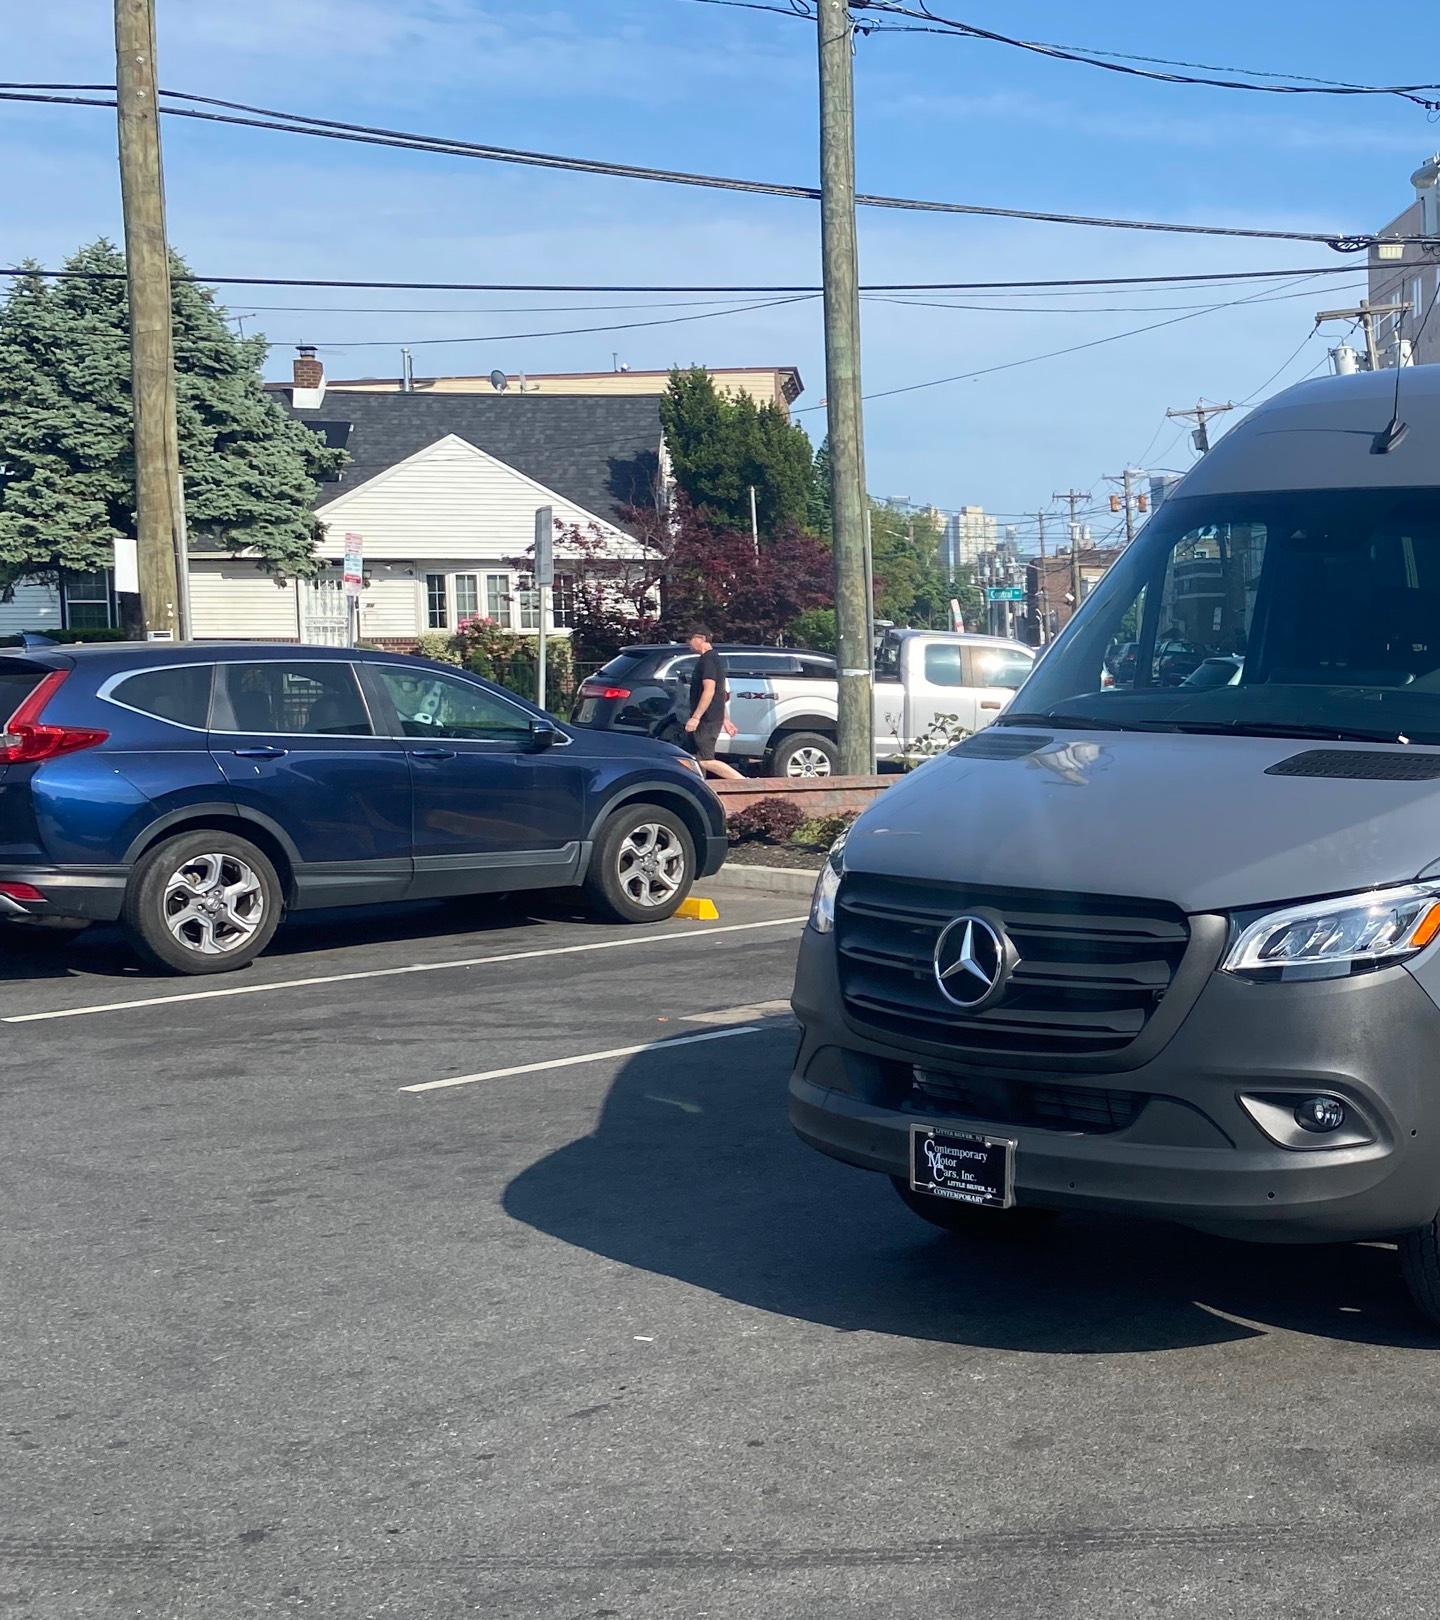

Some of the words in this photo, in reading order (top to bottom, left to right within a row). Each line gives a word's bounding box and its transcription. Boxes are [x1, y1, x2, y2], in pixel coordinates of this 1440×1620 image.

[924, 1139, 988, 1163] Contemporary
[928, 1151, 957, 1169] Motor
[947, 1180, 966, 1188] LITTLE
[961, 1170, 977, 1182] Inc.
[933, 1187, 984, 1203] CONTEMPORARY
